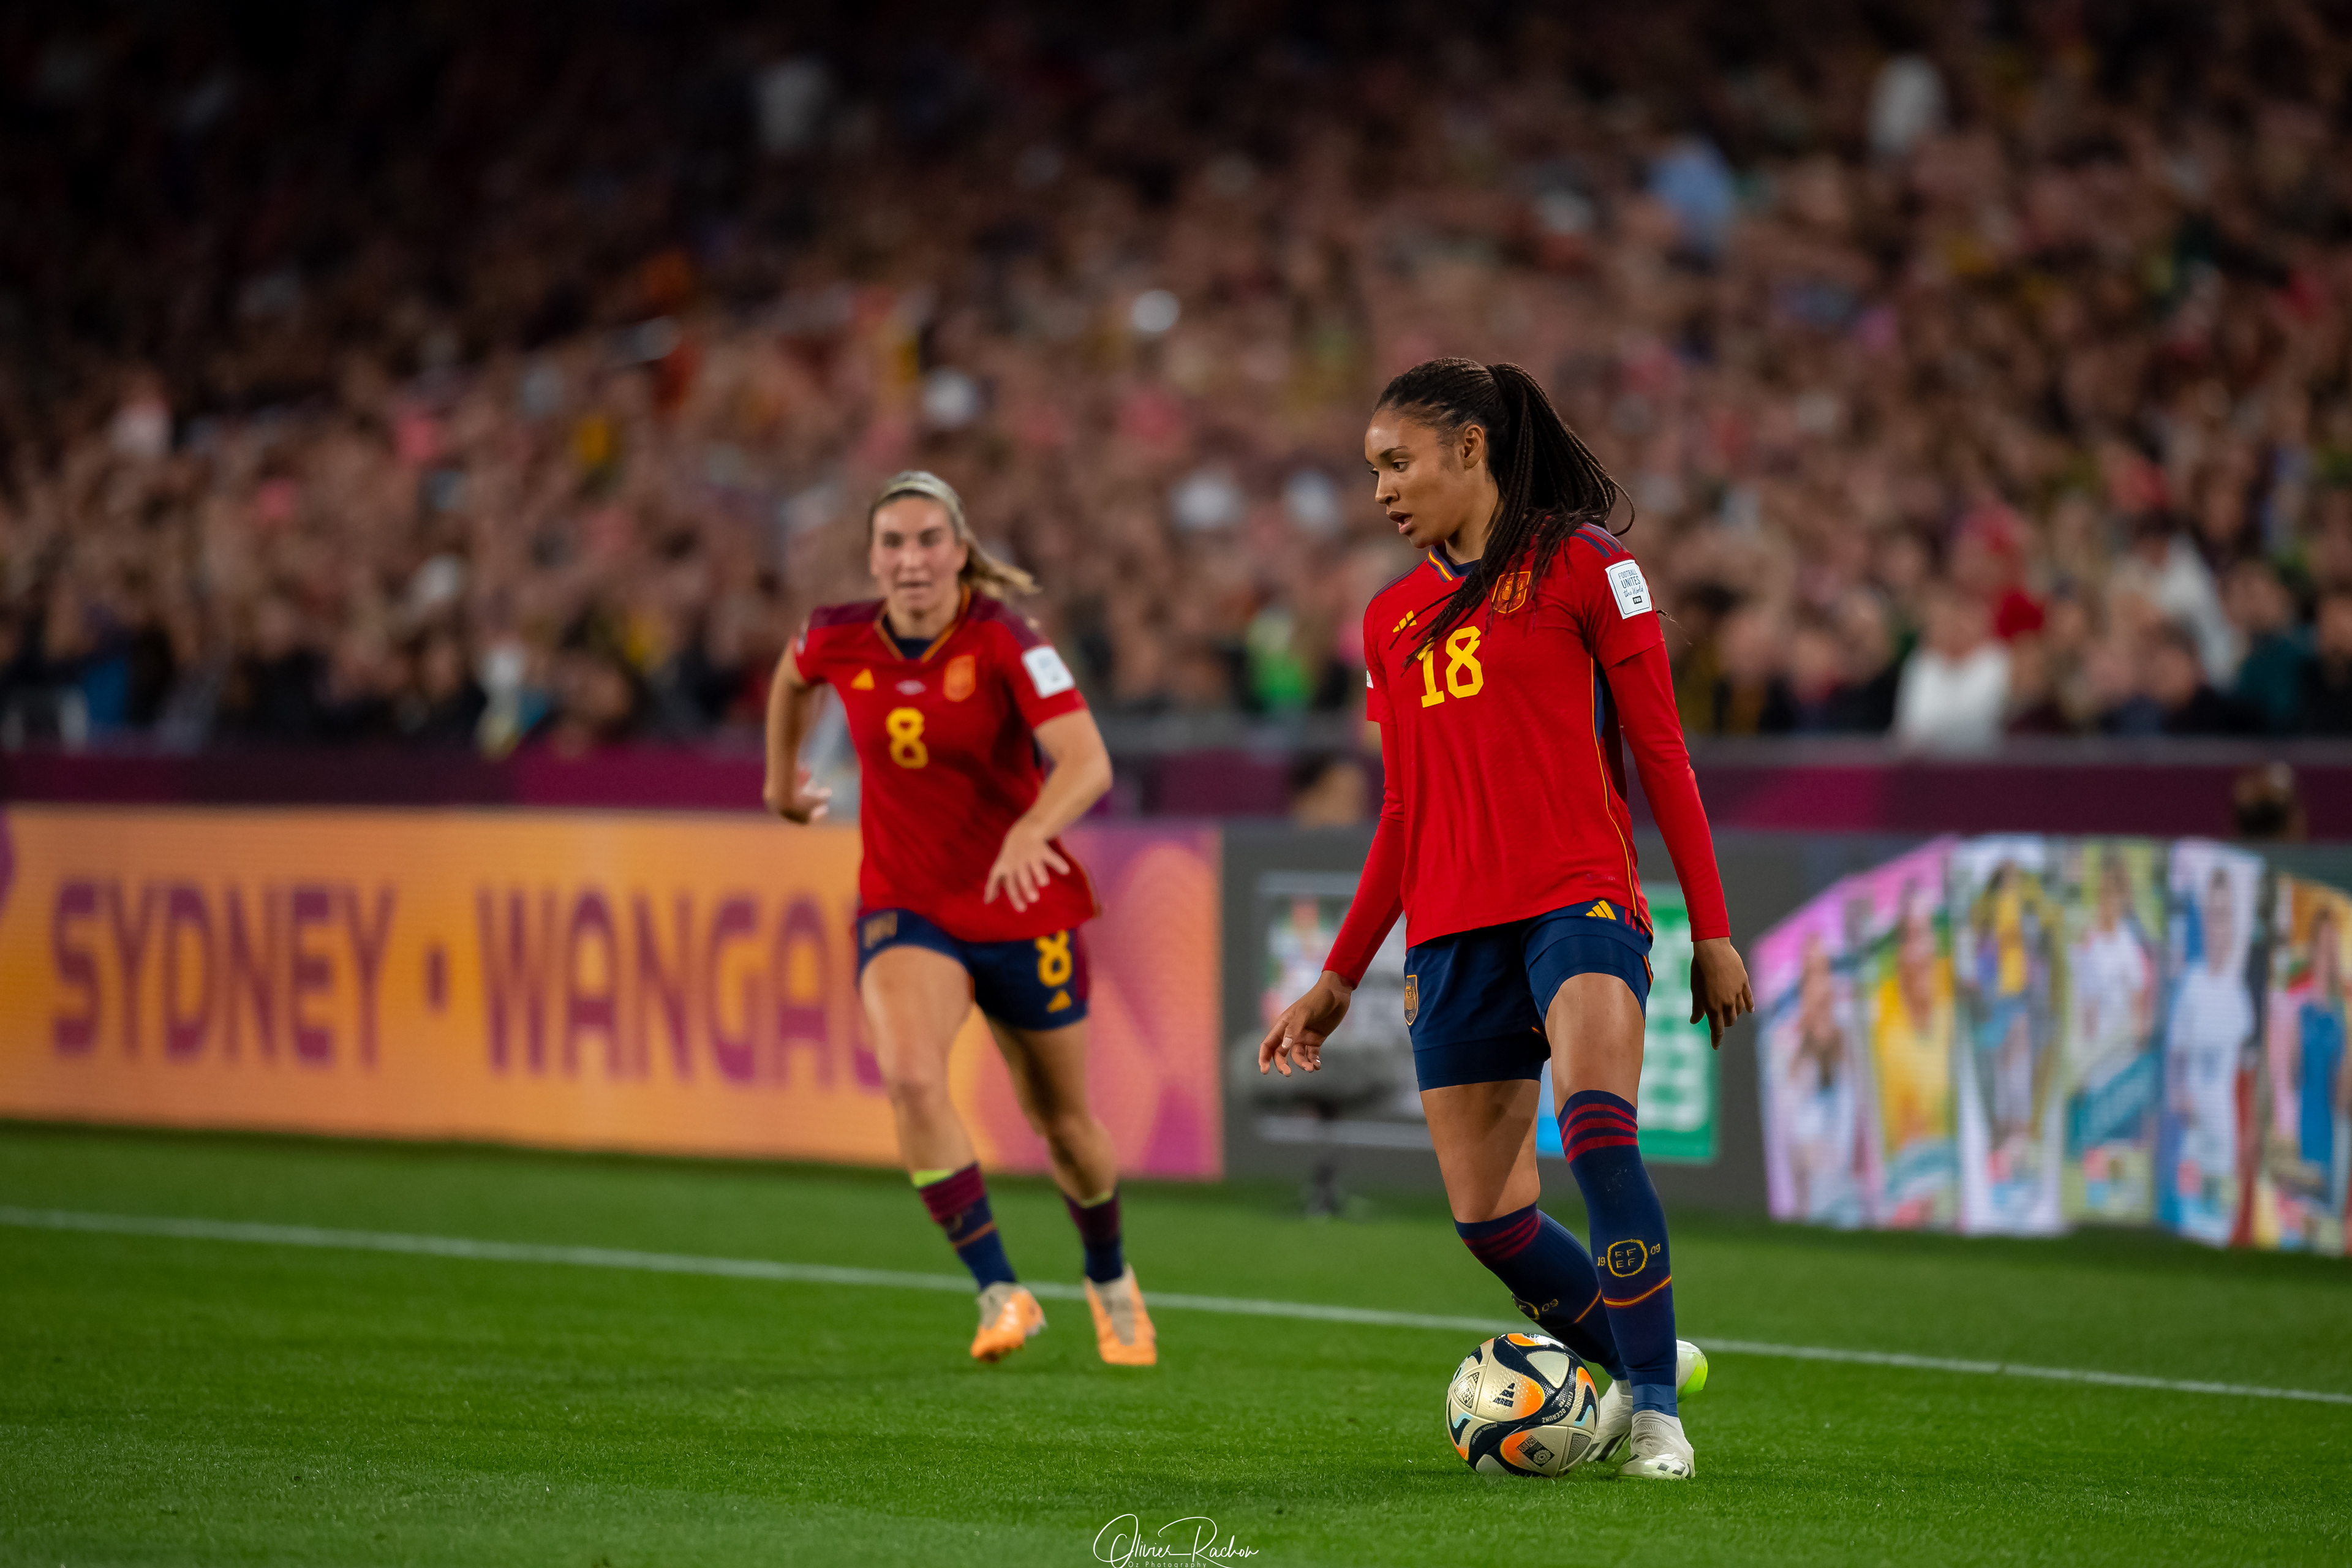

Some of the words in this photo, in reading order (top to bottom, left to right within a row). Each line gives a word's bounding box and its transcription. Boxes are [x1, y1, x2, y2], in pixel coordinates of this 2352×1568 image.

[1618, 568, 1637, 579] FOOTBALL
[1621, 576, 1641, 589] UNITES
[1623, 589, 1633, 598] the
[1416, 625, 1484, 708] 18
[886, 707, 929, 769] 8
[51, 876, 399, 1067] SYDNEY
[1035, 929, 1072, 987] 8
